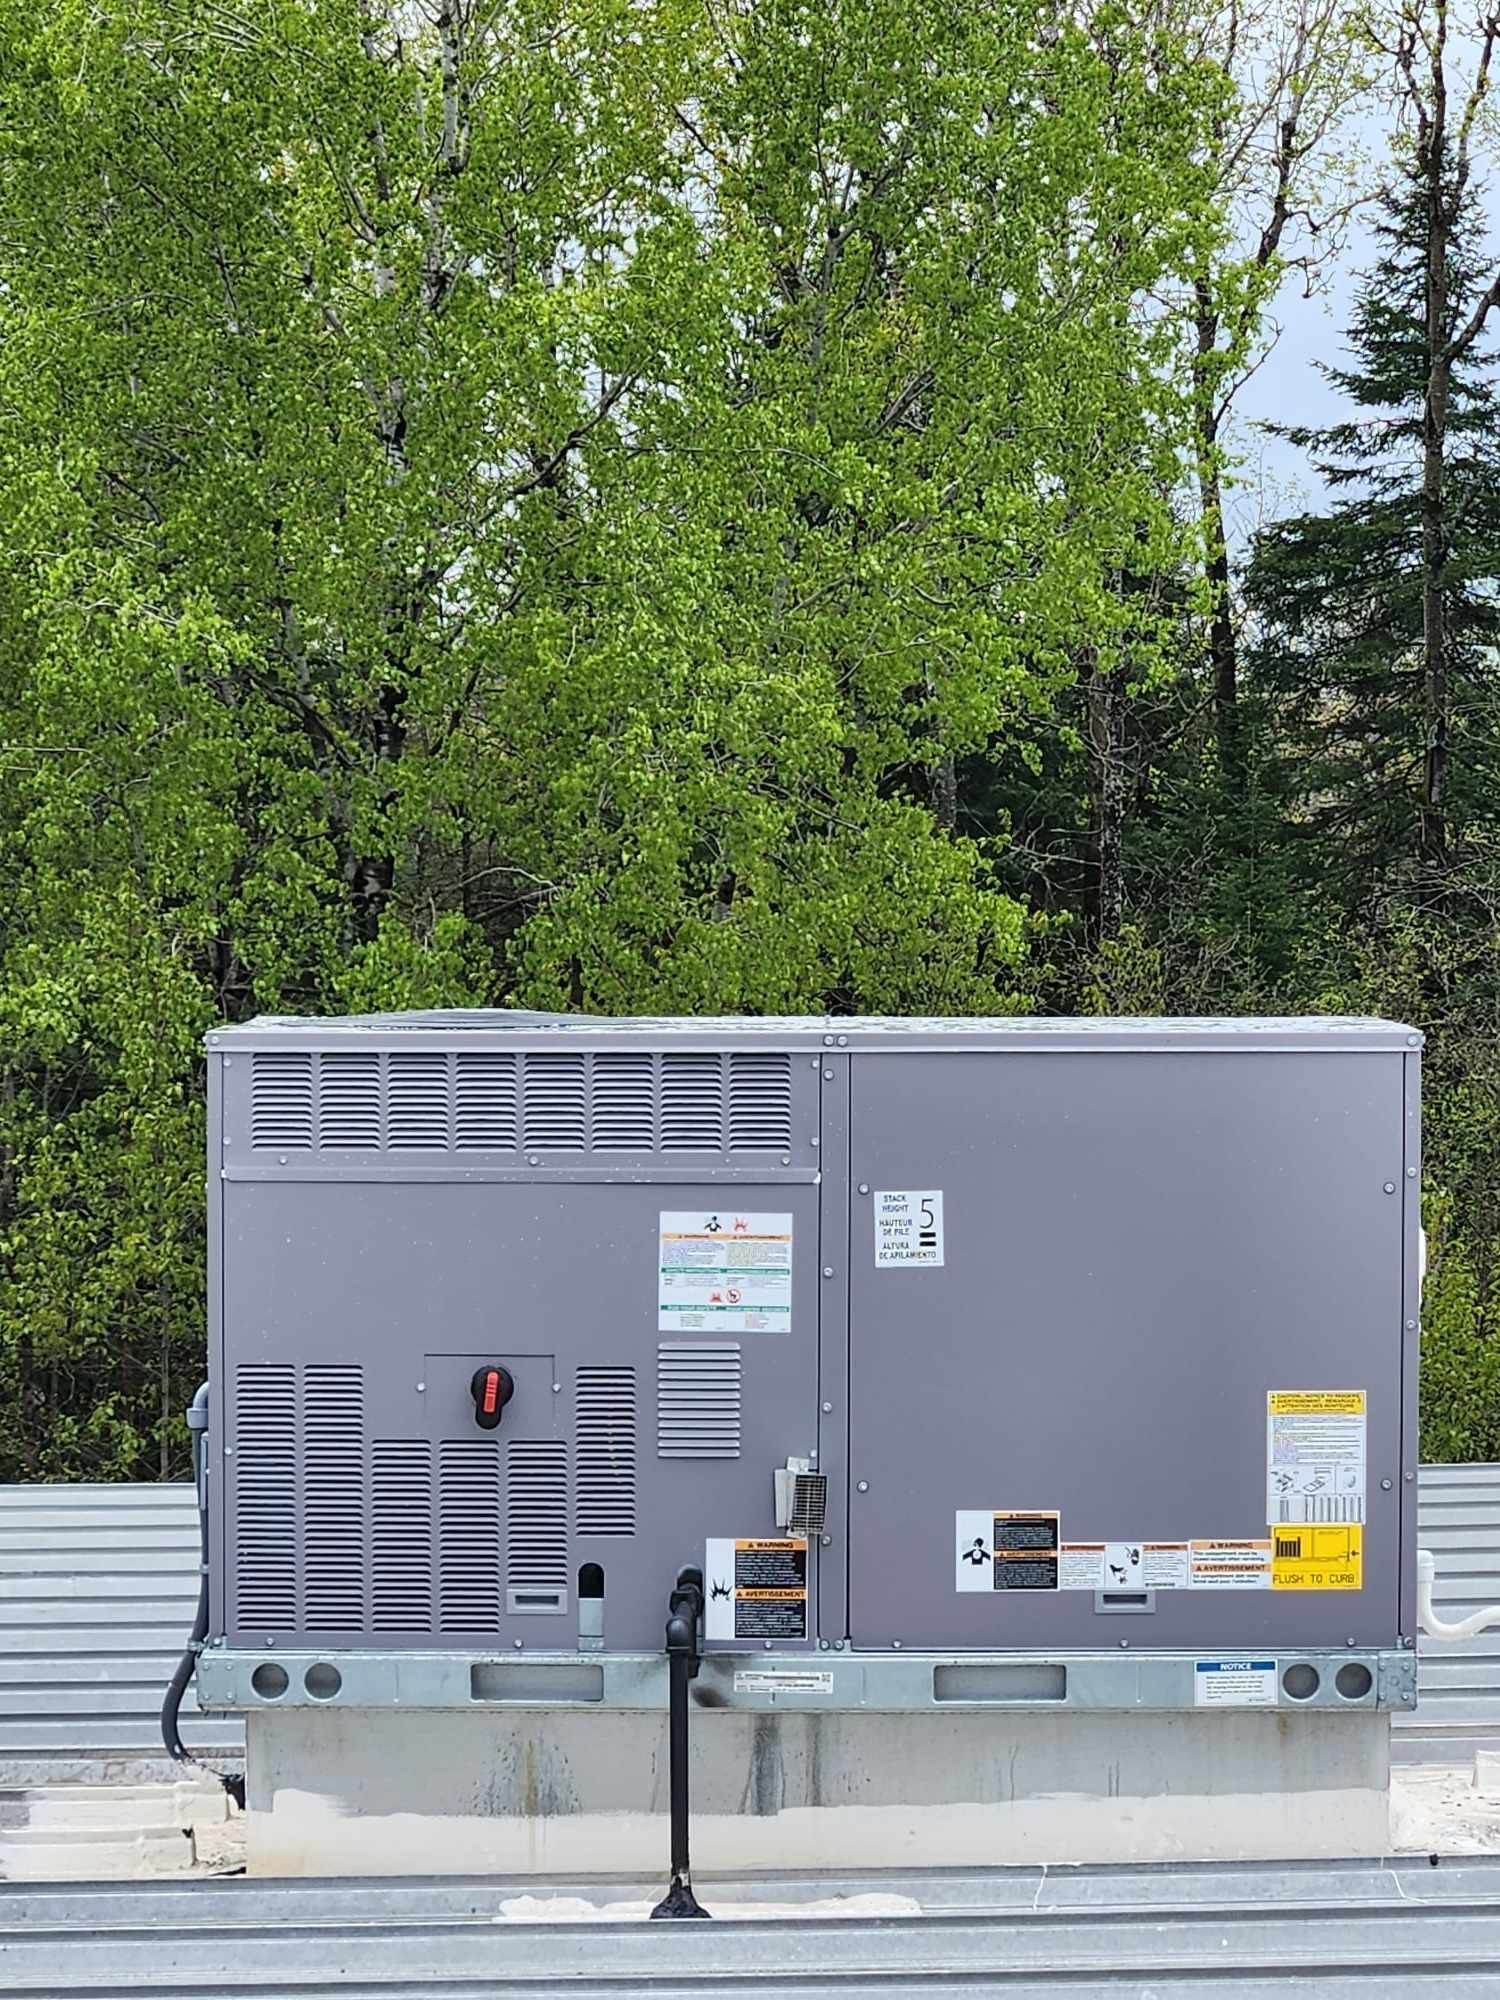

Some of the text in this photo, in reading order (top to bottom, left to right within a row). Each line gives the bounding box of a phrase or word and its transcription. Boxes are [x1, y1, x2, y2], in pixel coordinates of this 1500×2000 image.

[883, 1194, 906, 1203] STACK
[881, 1204, 909, 1212] HEIGHT
[920, 1198, 934, 1229] 5
[1272, 1573, 1355, 1584] FLUSH TO CURB
